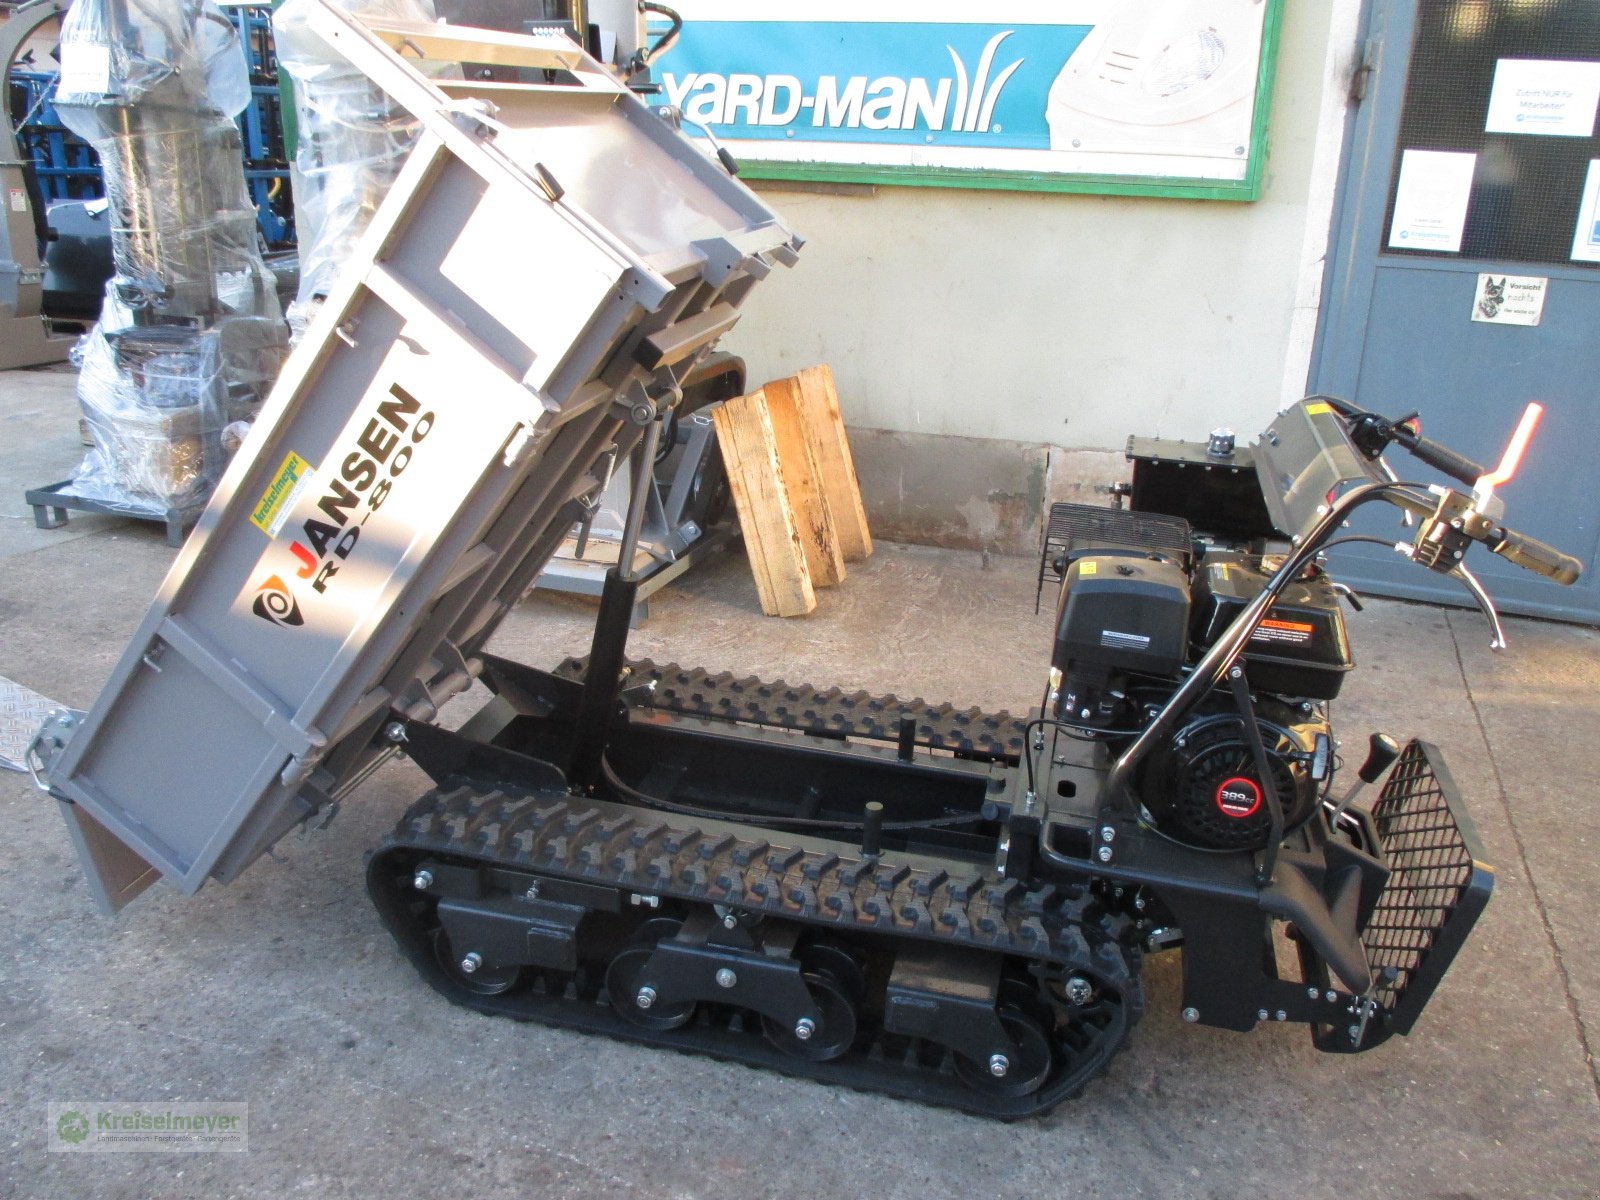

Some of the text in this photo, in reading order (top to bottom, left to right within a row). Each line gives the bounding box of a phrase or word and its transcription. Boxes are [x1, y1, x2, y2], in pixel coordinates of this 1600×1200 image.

[1509, 282, 1542, 291] Vorsicht
[289, 382, 421, 579] JANSEN
[312, 411, 435, 594] RD-800
[1264, 620, 1295, 629] WARNING
